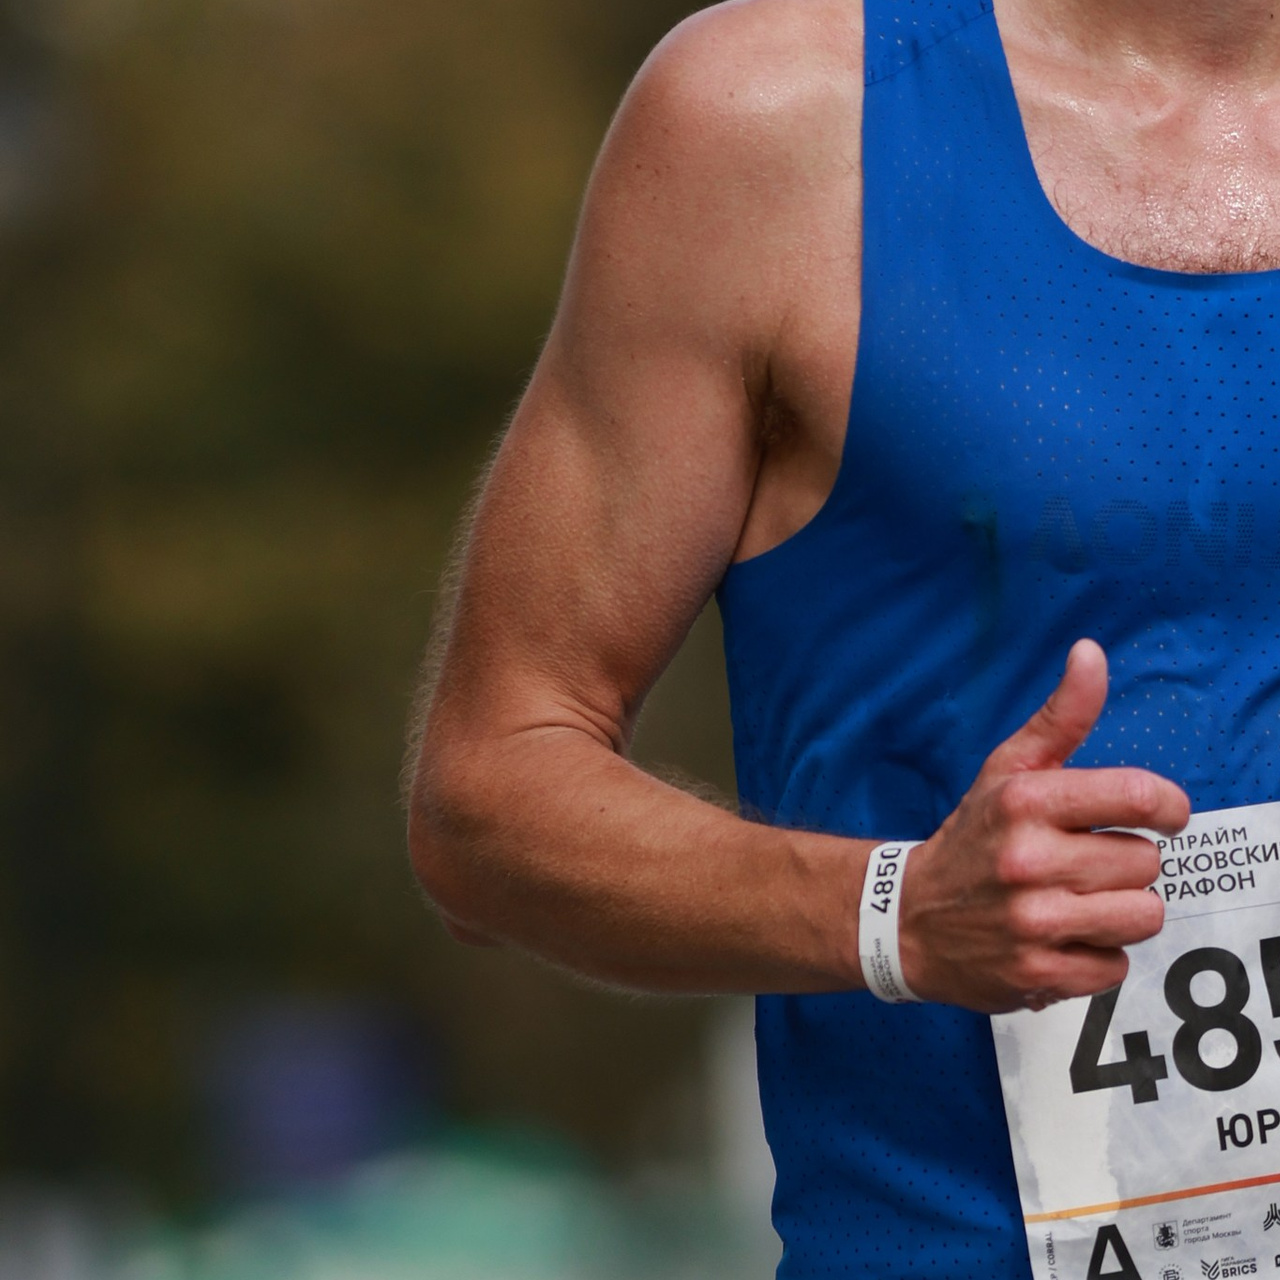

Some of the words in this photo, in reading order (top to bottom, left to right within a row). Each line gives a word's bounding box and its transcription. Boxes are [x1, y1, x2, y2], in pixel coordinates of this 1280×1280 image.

[1157, 826, 1248, 854] РПРАЙМ
[870, 847, 902, 914] 4850
[1149, 870, 1256, 902] РАФОН
[1182, 1212, 1232, 1227] Департамент
[1183, 1225, 1209, 1236] спорта
[1045, 1231, 1055, 1266] CORRAL
[1184, 1234, 1210, 1245] города
[1212, 1230, 1242, 1240] Москвы
[1221, 1263, 1258, 1279] BRICS
